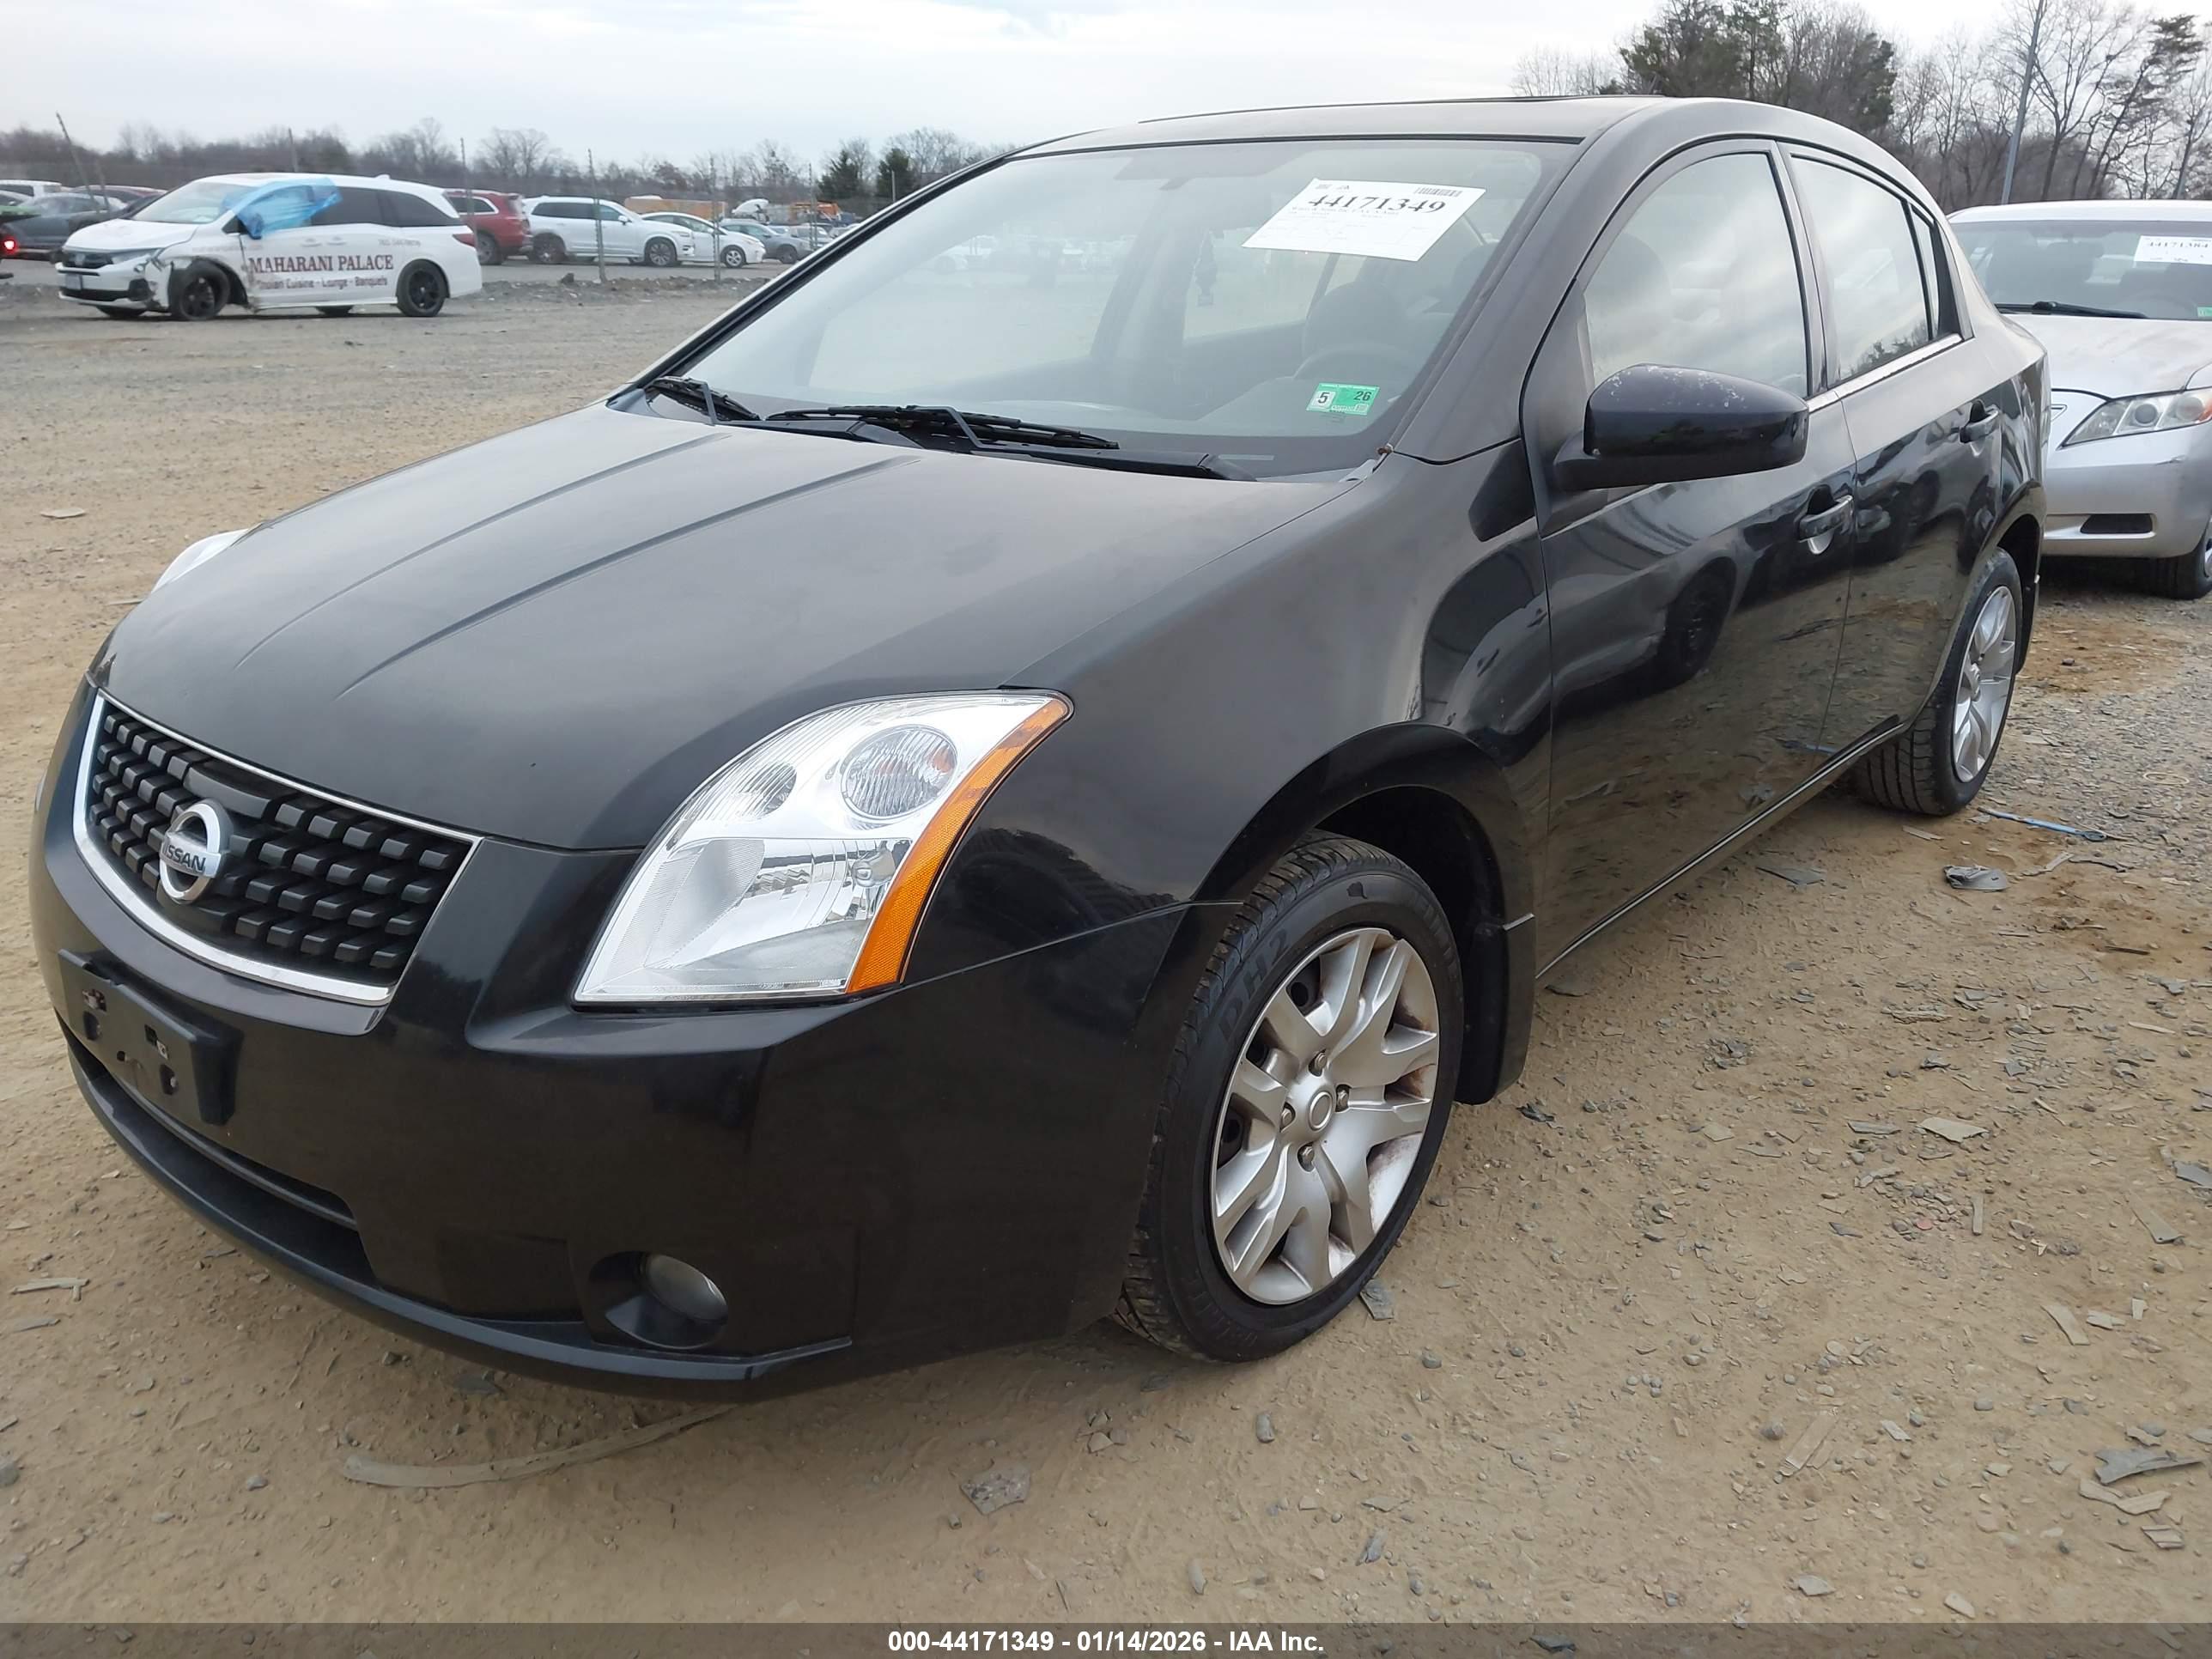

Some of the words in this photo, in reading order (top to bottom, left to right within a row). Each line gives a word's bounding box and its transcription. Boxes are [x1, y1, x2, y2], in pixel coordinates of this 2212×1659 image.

[1309, 194, 1446, 214] 44171349
[249, 256, 332, 274] MAHARANI
[337, 254, 394, 271] PALACE
[286, 277, 314, 289] Cuisine
[1317, 392, 1330, 404] 5
[1353, 391, 1372, 402] 26
